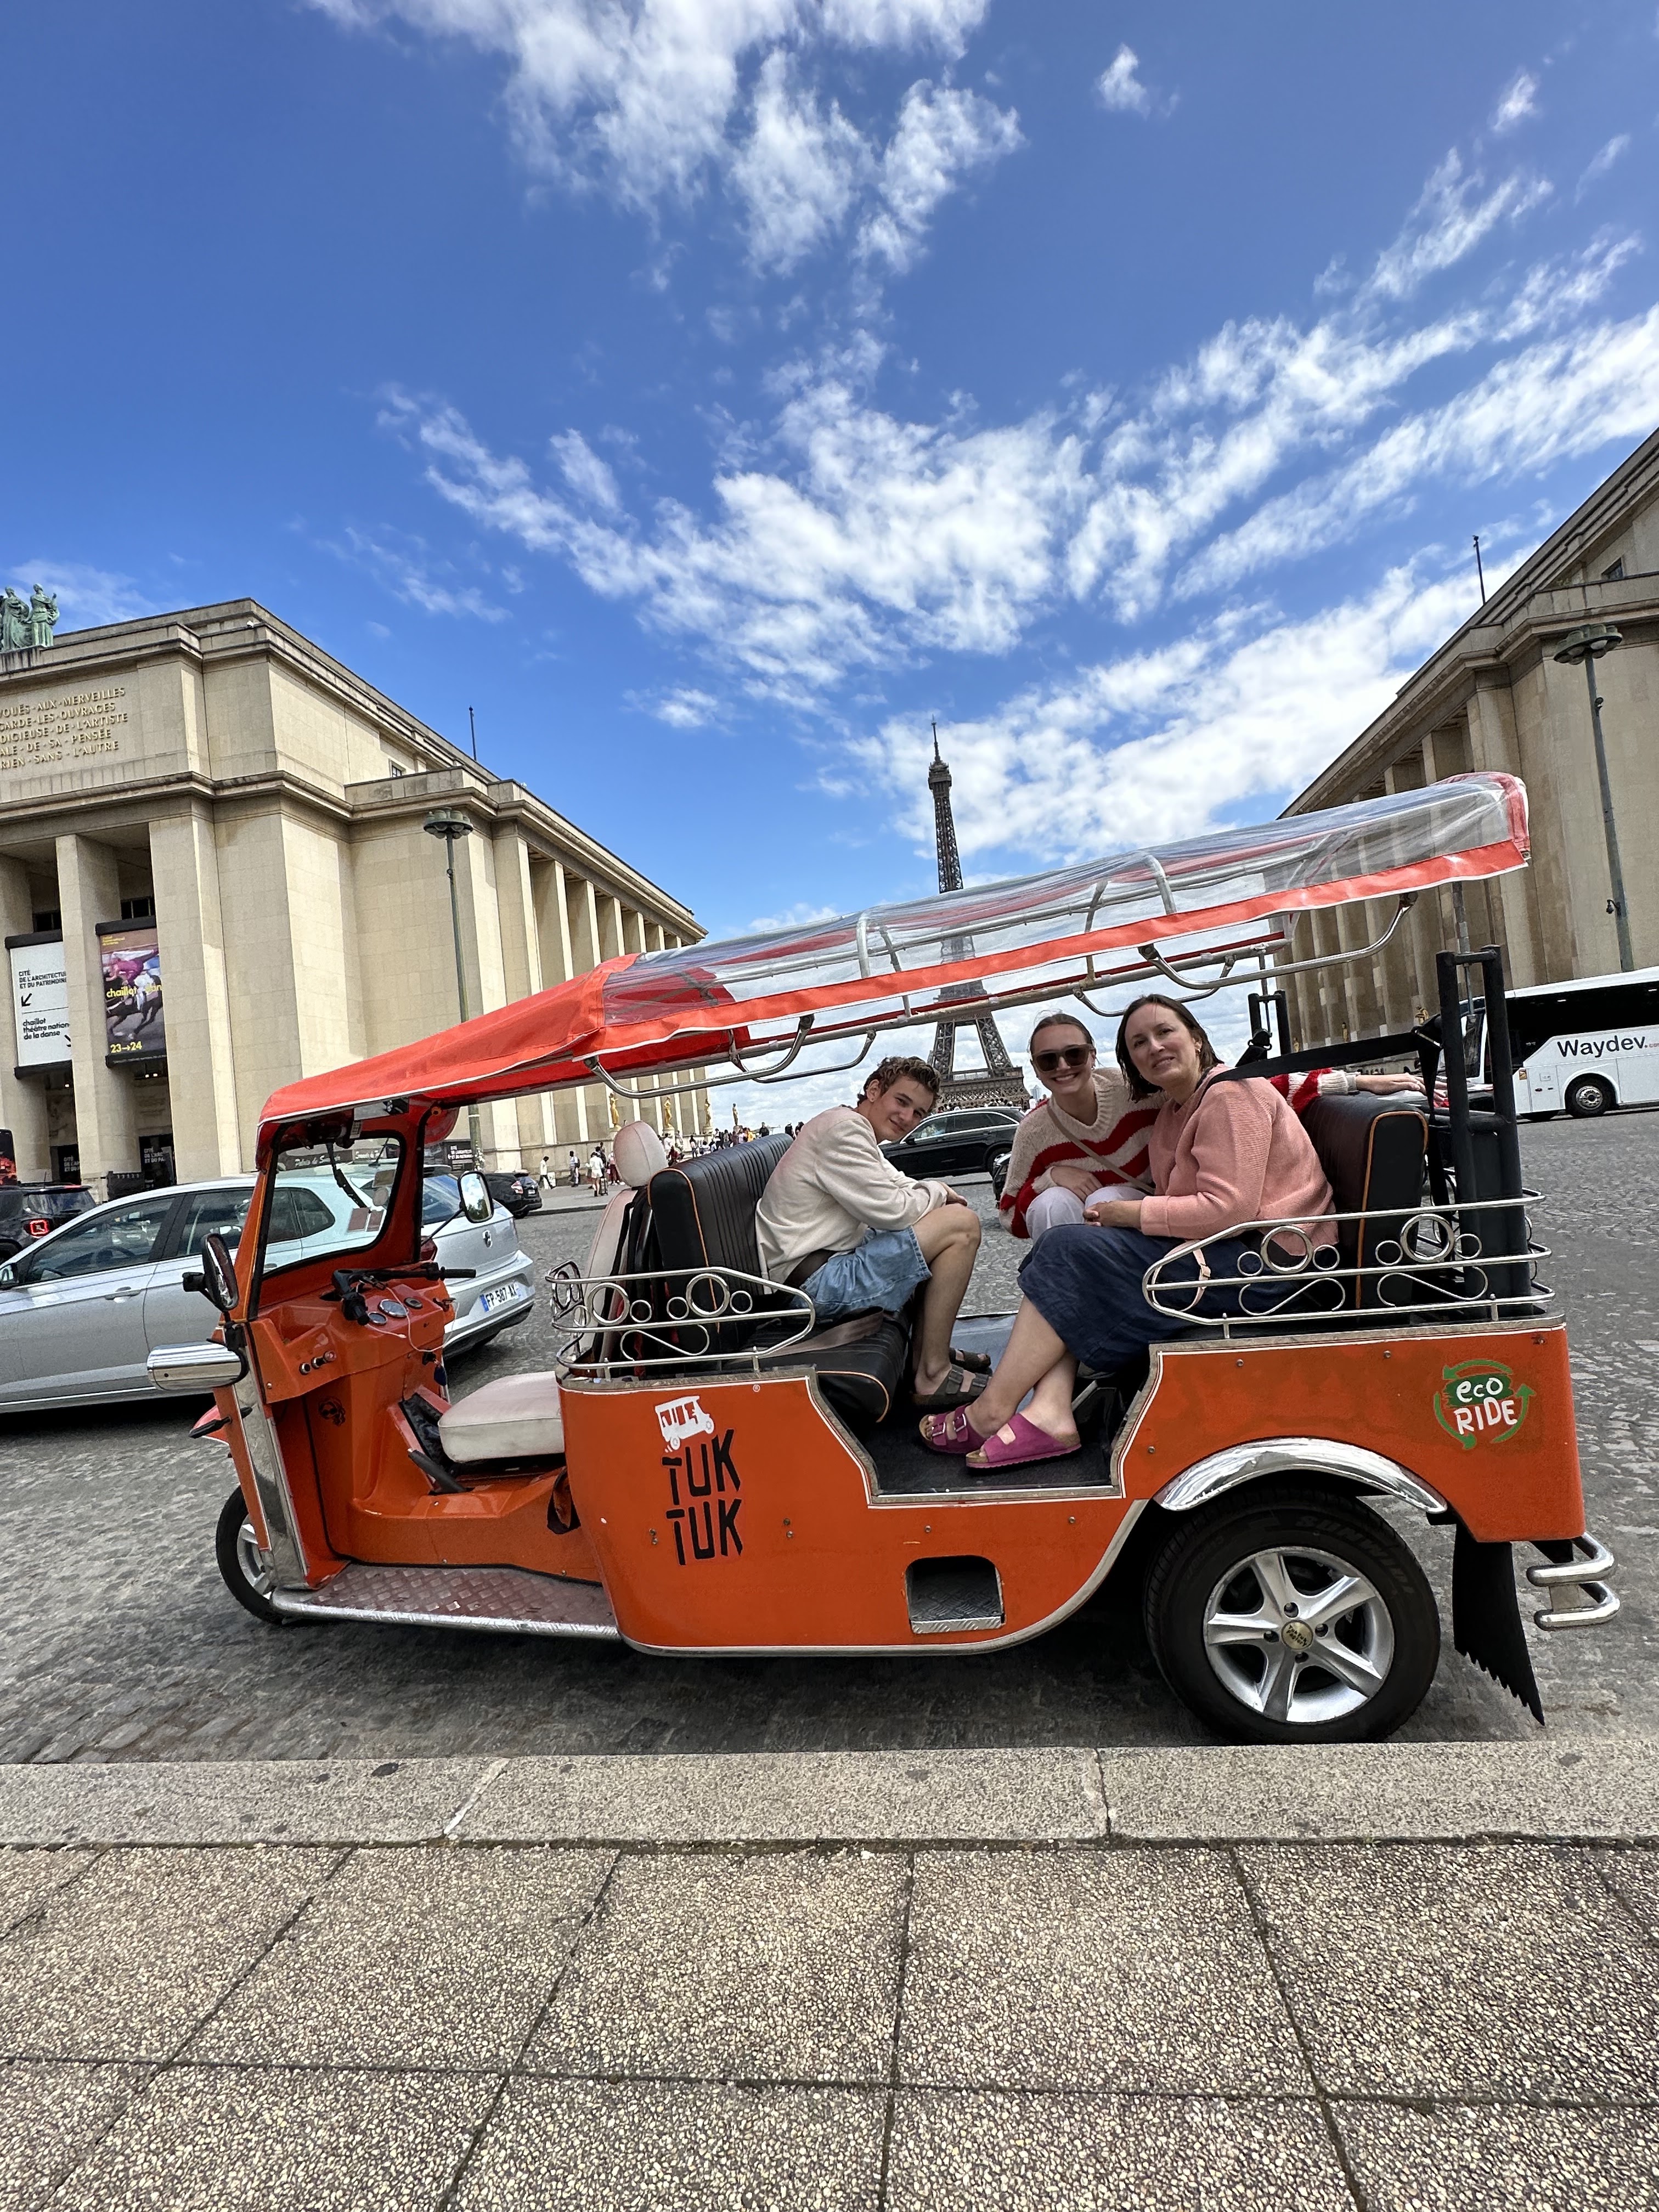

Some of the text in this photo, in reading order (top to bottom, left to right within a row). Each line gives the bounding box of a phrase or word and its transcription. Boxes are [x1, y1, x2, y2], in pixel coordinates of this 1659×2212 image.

[38, 699, 57, 712] AUX
[64, 687, 126, 707] MERVEILLES
[38, 713, 54, 725] LES
[60, 703, 116, 720] OUVRAGES
[57, 724, 70, 734] DE
[77, 713, 128, 730] L'ARTISTE
[27, 742, 40, 752] DE
[49, 738, 63, 748] SA
[72, 729, 111, 744] PENSÉE
[0, 741, 119, 769] RIEN SANS L'AUTRE
[19, 968, 31, 977] CITÉ
[22, 1018, 46, 1026] chaillot
[48, 1022, 70, 1030] nation
[110, 1041, 142, 1053] 23 24
[1457, 1377, 1504, 1403] eco
[1454, 1397, 1517, 1435] RIDE
[662, 1429, 741, 1505] TUK
[666, 1499, 743, 1566] TUK
